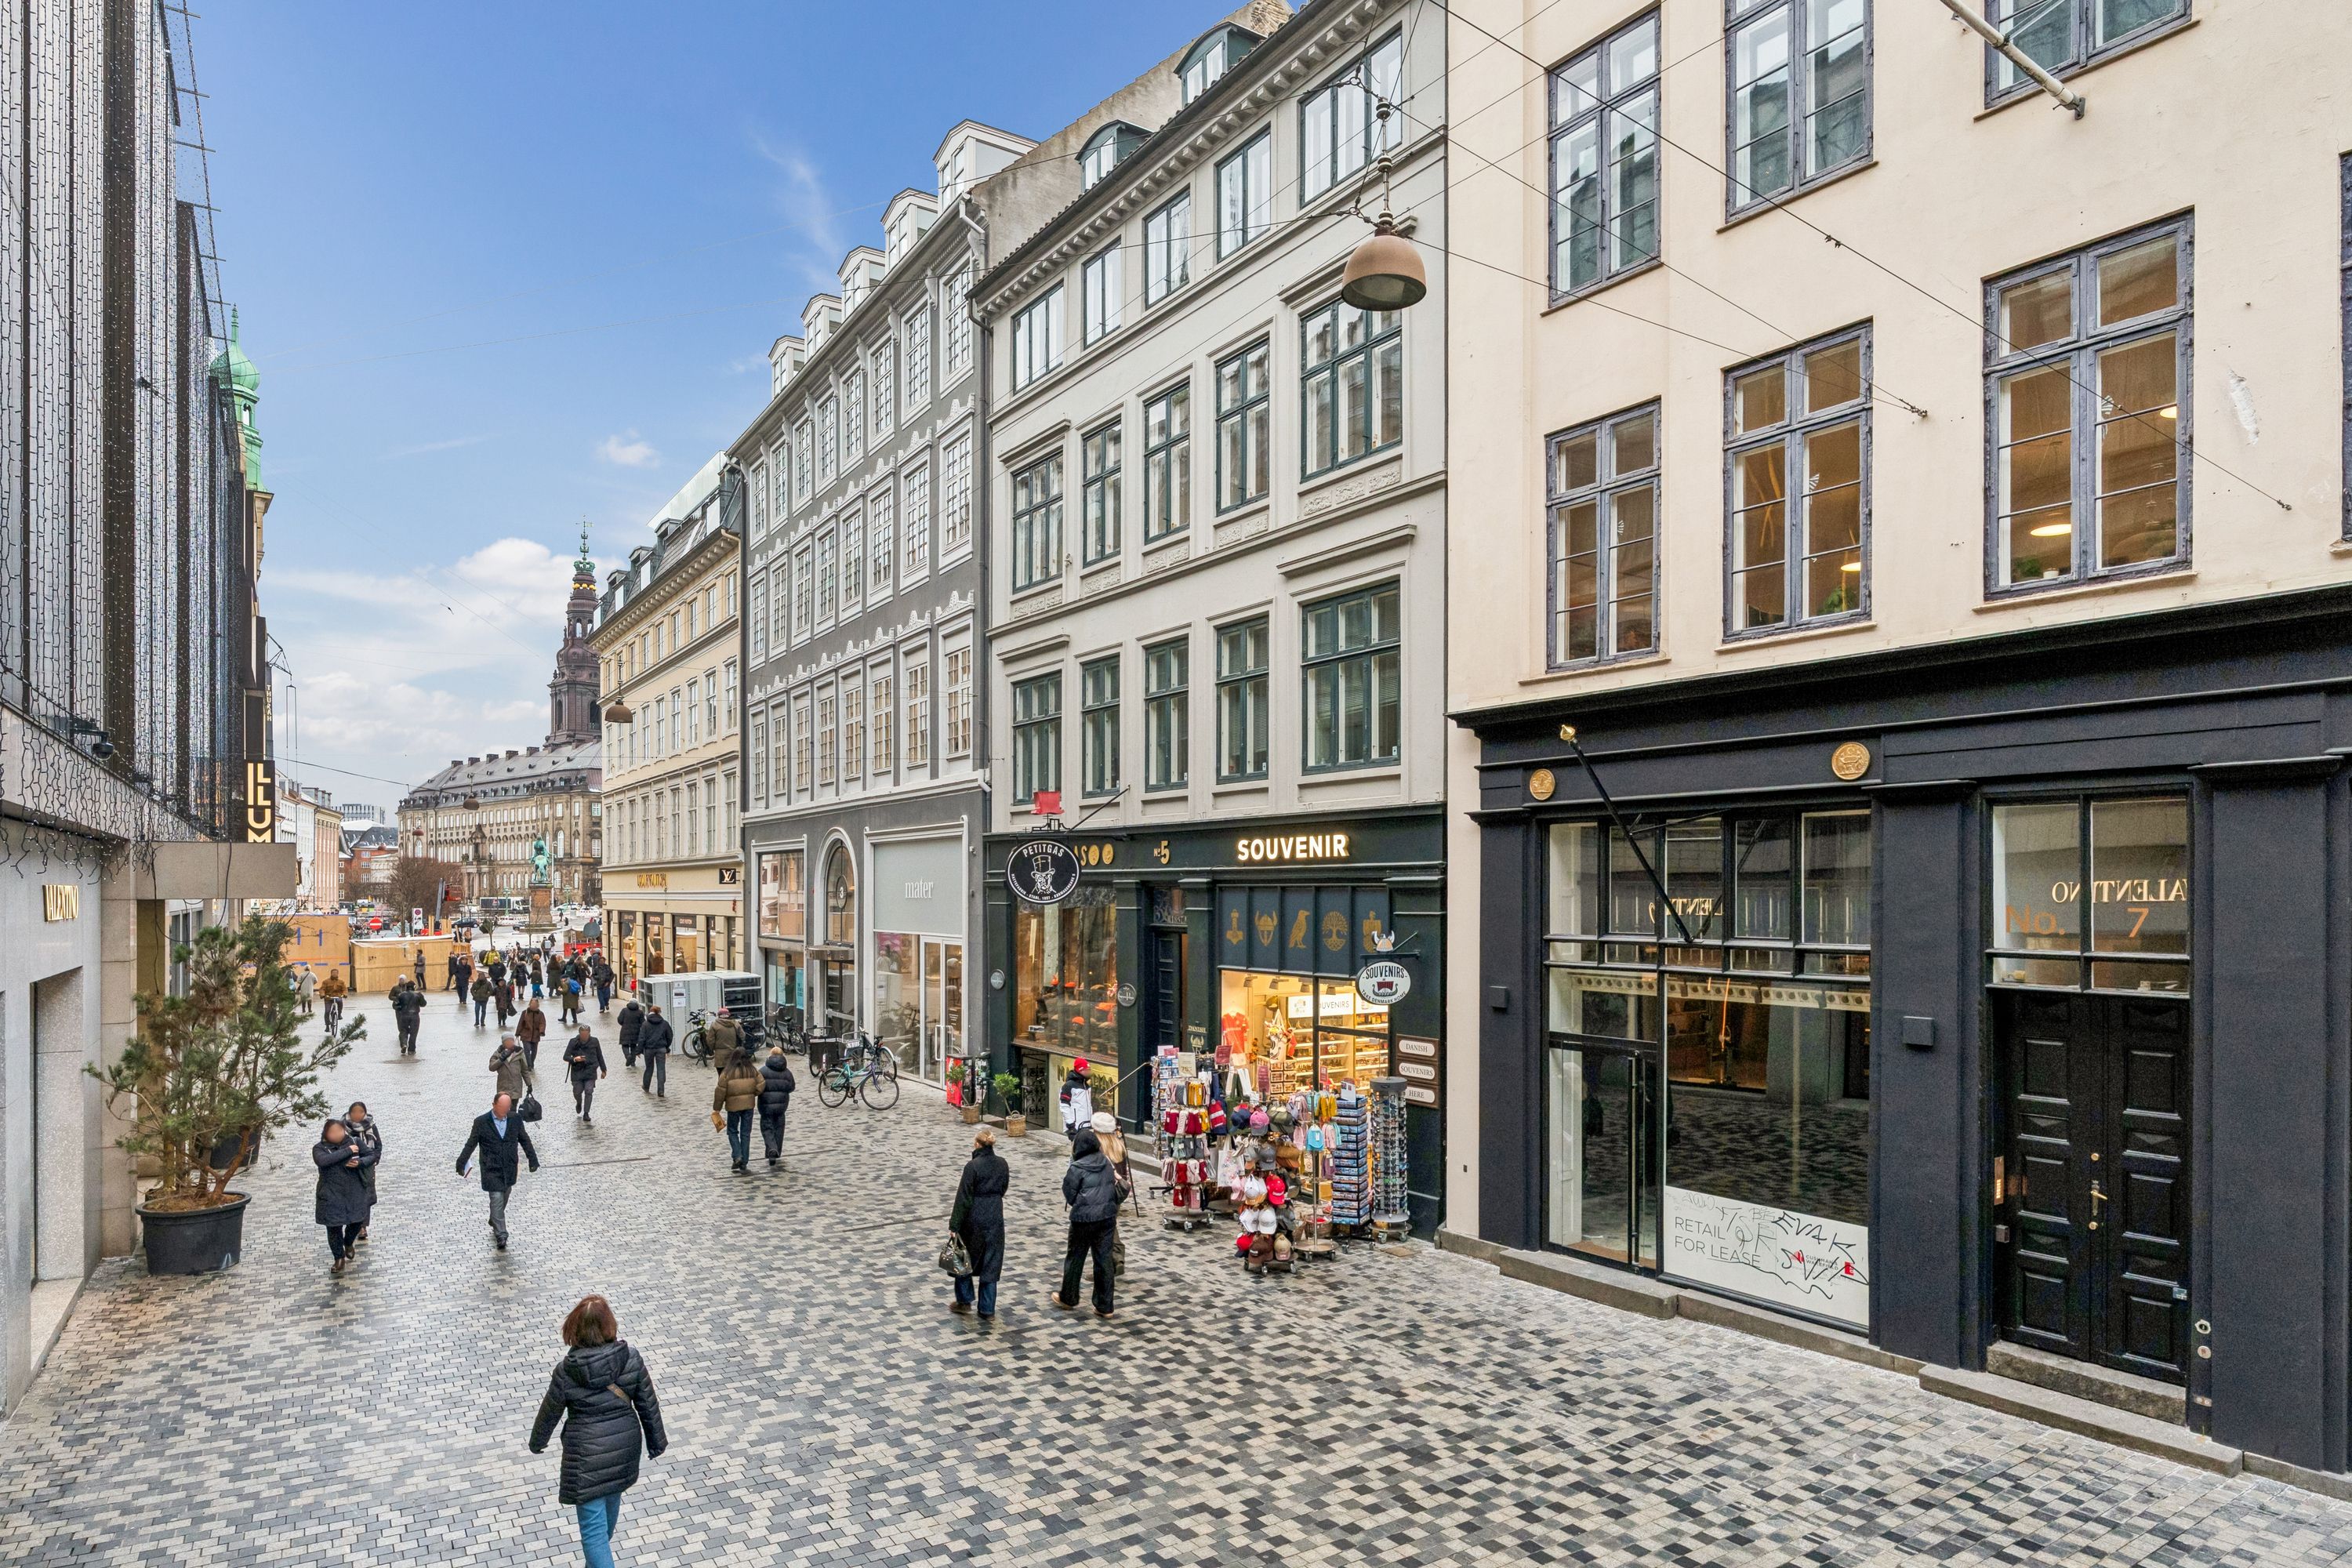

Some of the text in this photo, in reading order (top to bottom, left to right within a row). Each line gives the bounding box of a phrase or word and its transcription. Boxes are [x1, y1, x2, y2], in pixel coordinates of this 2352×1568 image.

[1022, 844, 1065, 858] PETITGAS
[1237, 834, 1348, 861] SOUVENIR
[840, 886, 844, 899] 3
[905, 878, 934, 898] mater
[2005, 904, 2149, 938] No. 7
[1365, 965, 1405, 980] SOUVENIRS
[1362, 989, 1371, 1001] TAKE
[1394, 991, 1406, 1003] HOME
[1406, 1043, 1428, 1053] DANISH
[1400, 1065, 1433, 1076] SOUVENIRS
[1409, 1090, 1425, 1099] HERE
[1675, 1216, 1726, 1240] RETAIL
[1675, 1236, 1705, 1255] FOR
[1711, 1244, 1761, 1269] LEASE
